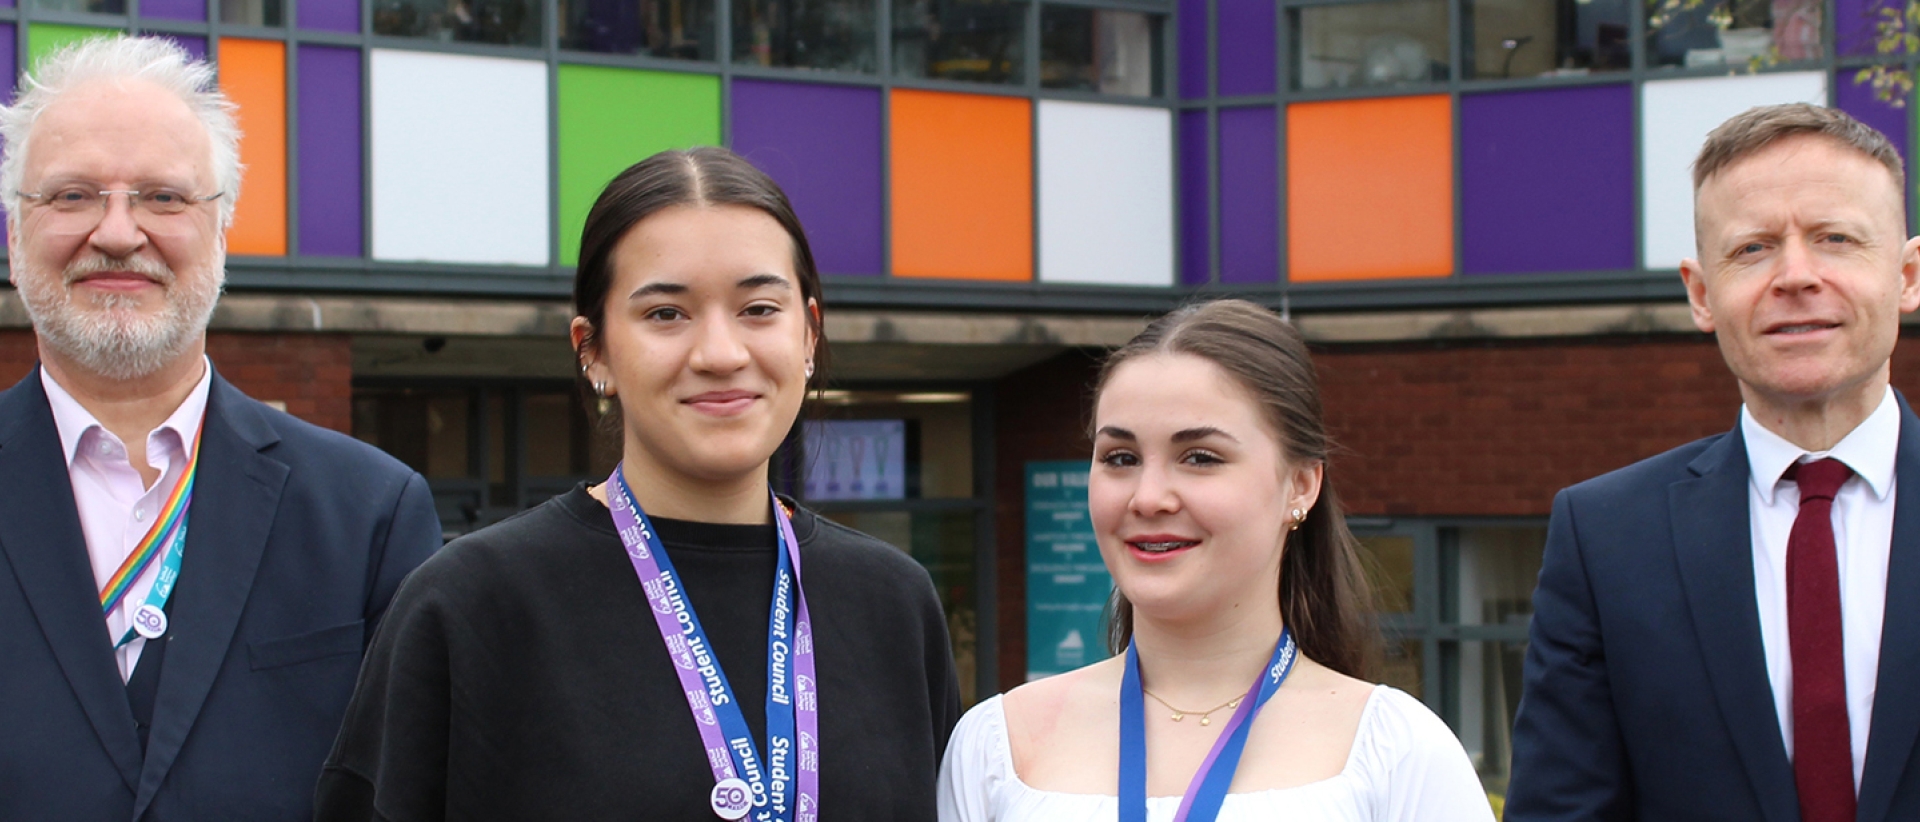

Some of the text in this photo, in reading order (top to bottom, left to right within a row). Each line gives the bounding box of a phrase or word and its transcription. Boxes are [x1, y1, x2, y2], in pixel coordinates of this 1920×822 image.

[660, 570, 695, 635] Council
[771, 569, 790, 705] Student Council
[687, 636, 730, 706] Student
[1271, 634, 1295, 684] Student
[715, 786, 745, 808] 50
[731, 737, 768, 807] Council
[771, 736, 790, 814] Student
